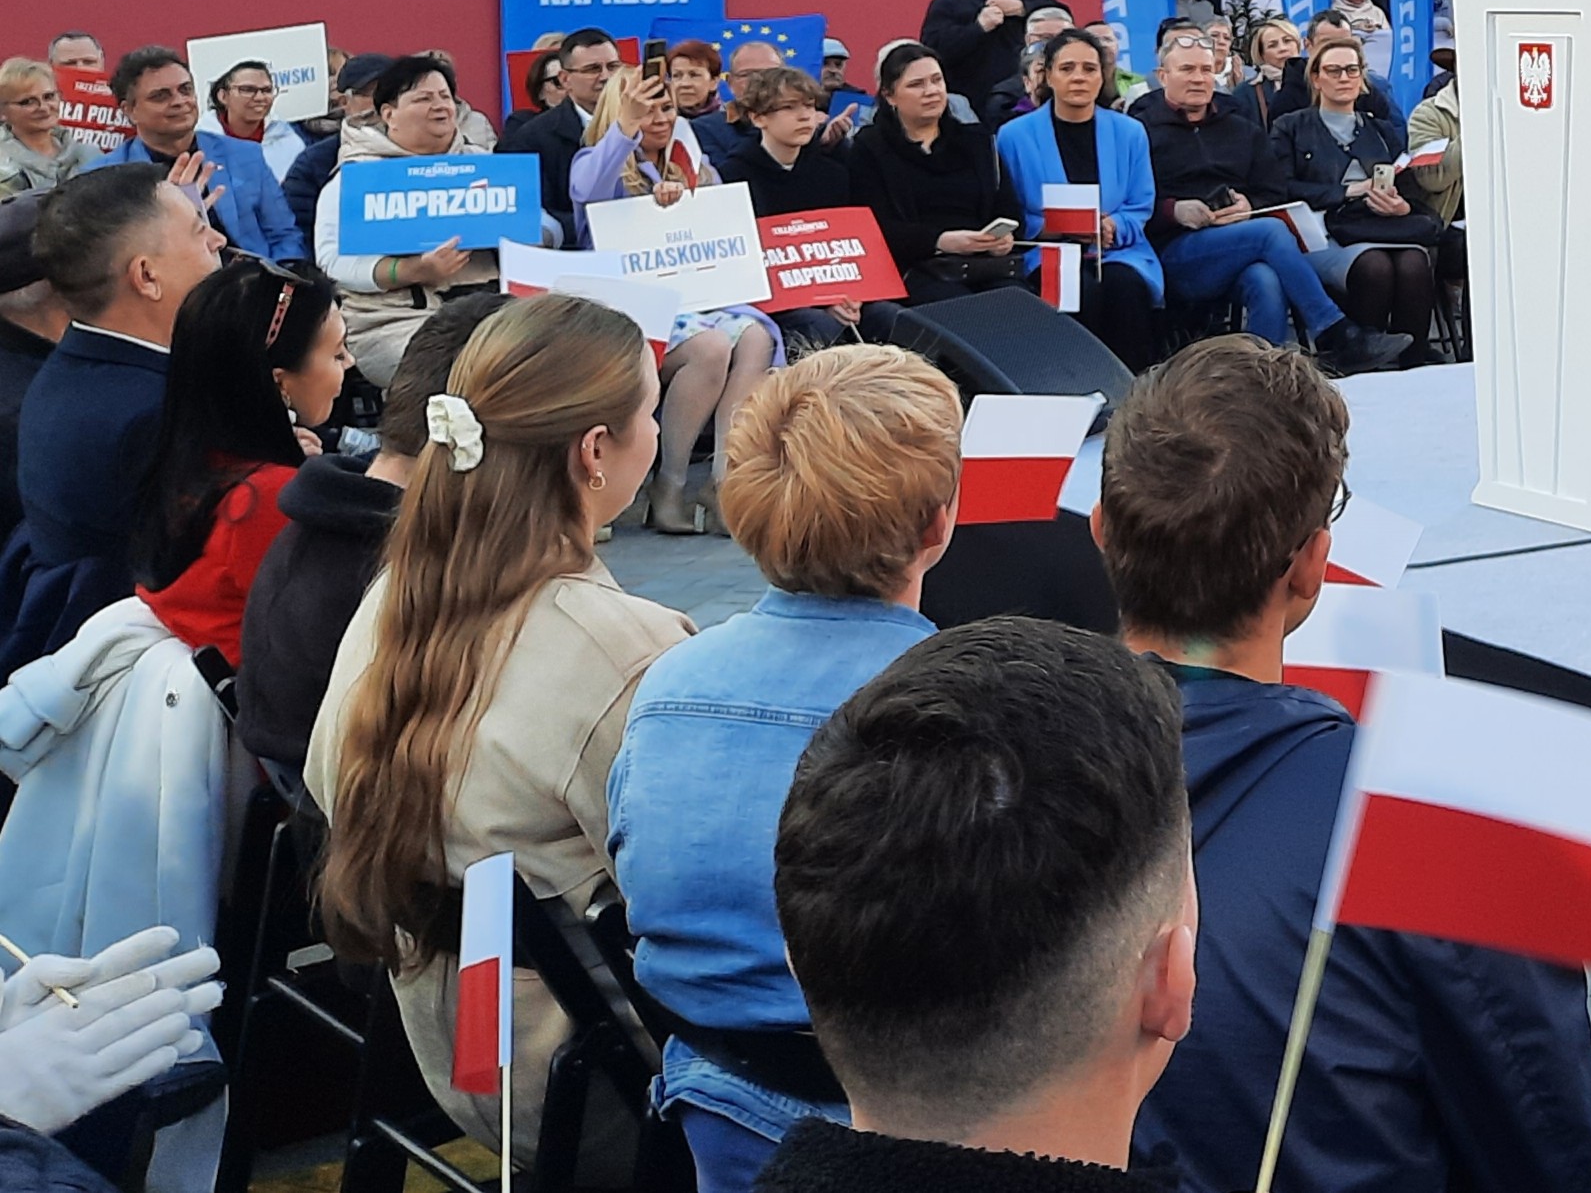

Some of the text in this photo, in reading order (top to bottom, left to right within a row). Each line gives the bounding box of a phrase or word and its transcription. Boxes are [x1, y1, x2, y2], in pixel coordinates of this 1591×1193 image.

[364, 178, 517, 222] NAPRZÓD!
[621, 235, 747, 274] TRZASKOWSKI
[801, 238, 866, 262] POLSKA
[778, 258, 862, 289] NAPRZÓD!
